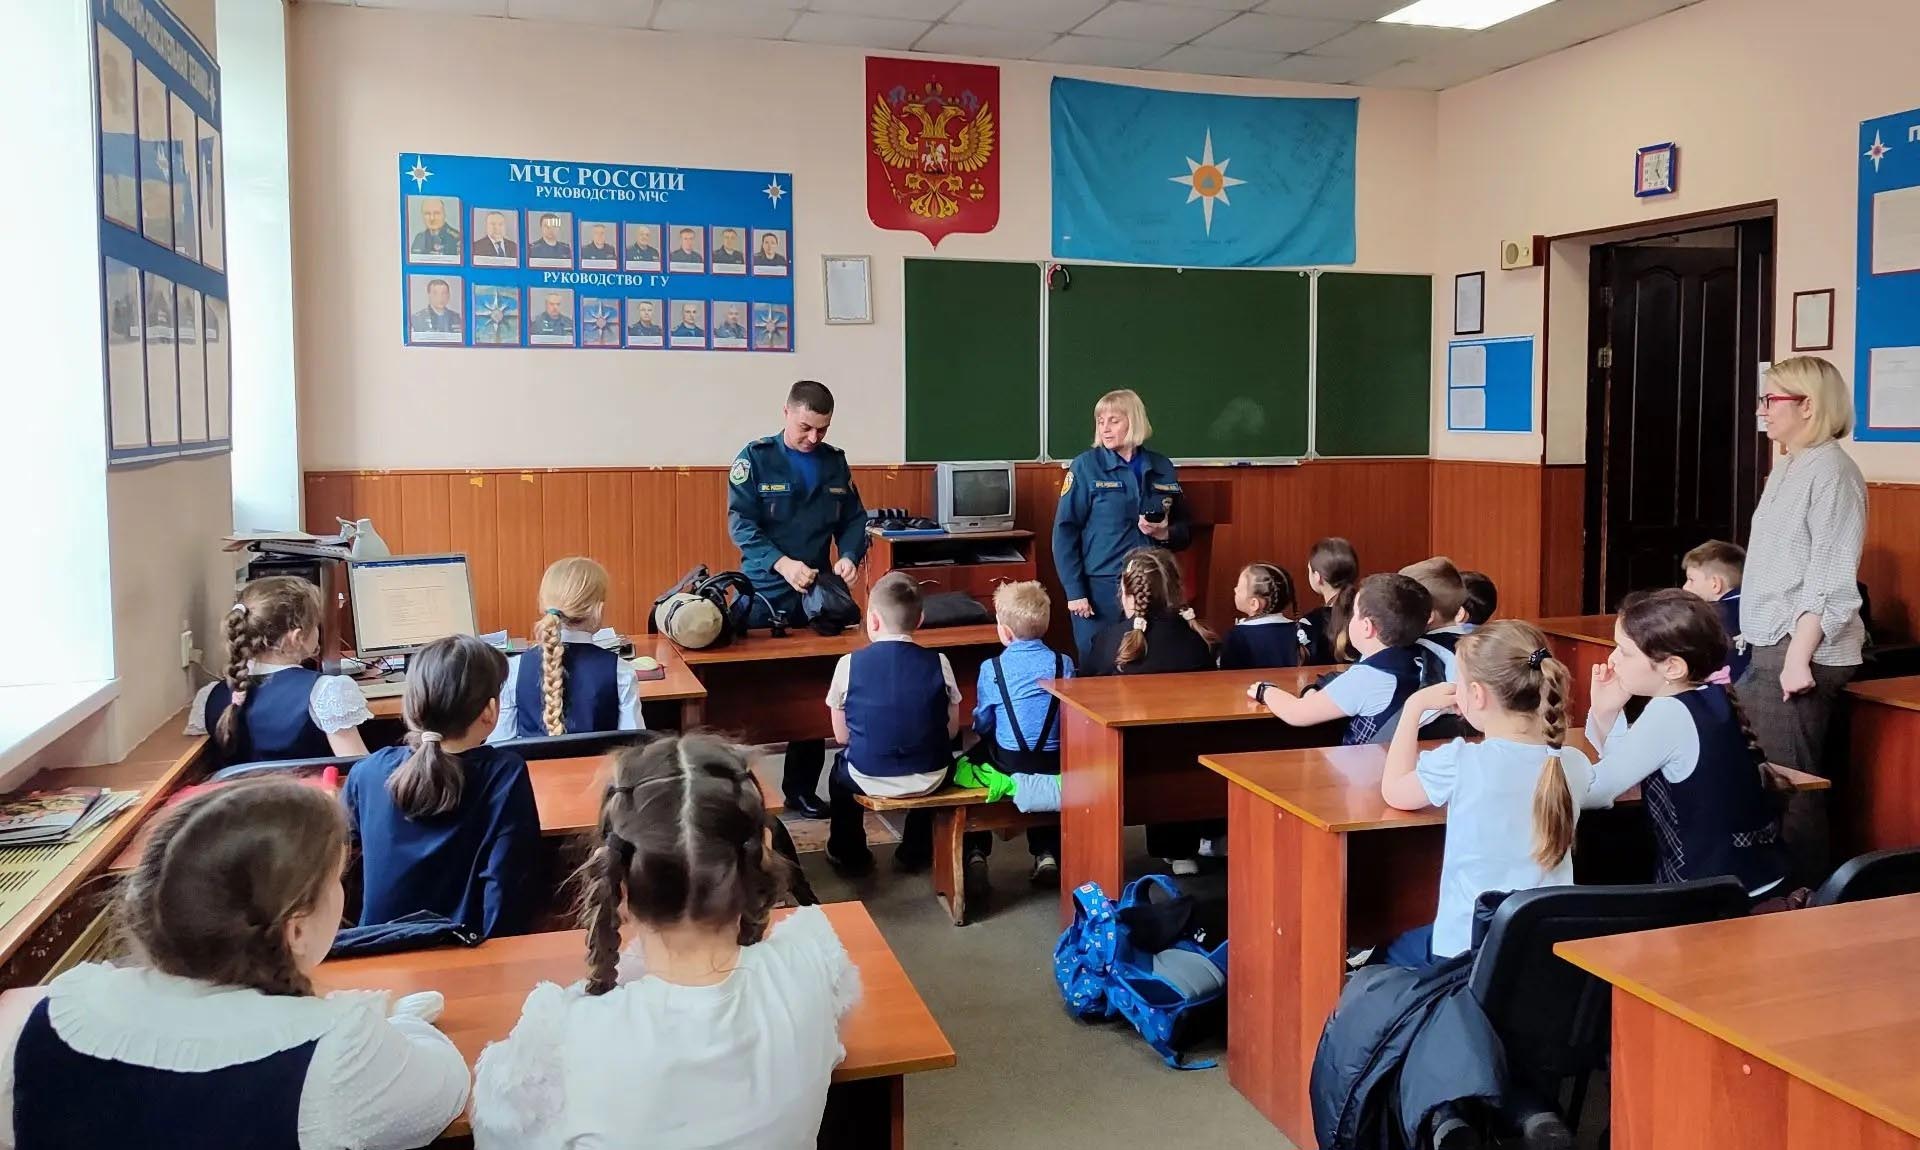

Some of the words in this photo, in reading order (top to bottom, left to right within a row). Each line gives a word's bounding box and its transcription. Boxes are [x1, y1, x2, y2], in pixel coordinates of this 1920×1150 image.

[509, 164, 570, 185] МЧС
[577, 168, 685, 191] РОССИИ
[536, 185, 636, 202] РУКОВОДСТВО
[638, 190, 669, 203] МЧС
[543, 271, 643, 287] РУКОВОДСТВО
[650, 275, 670, 288] ГУ
